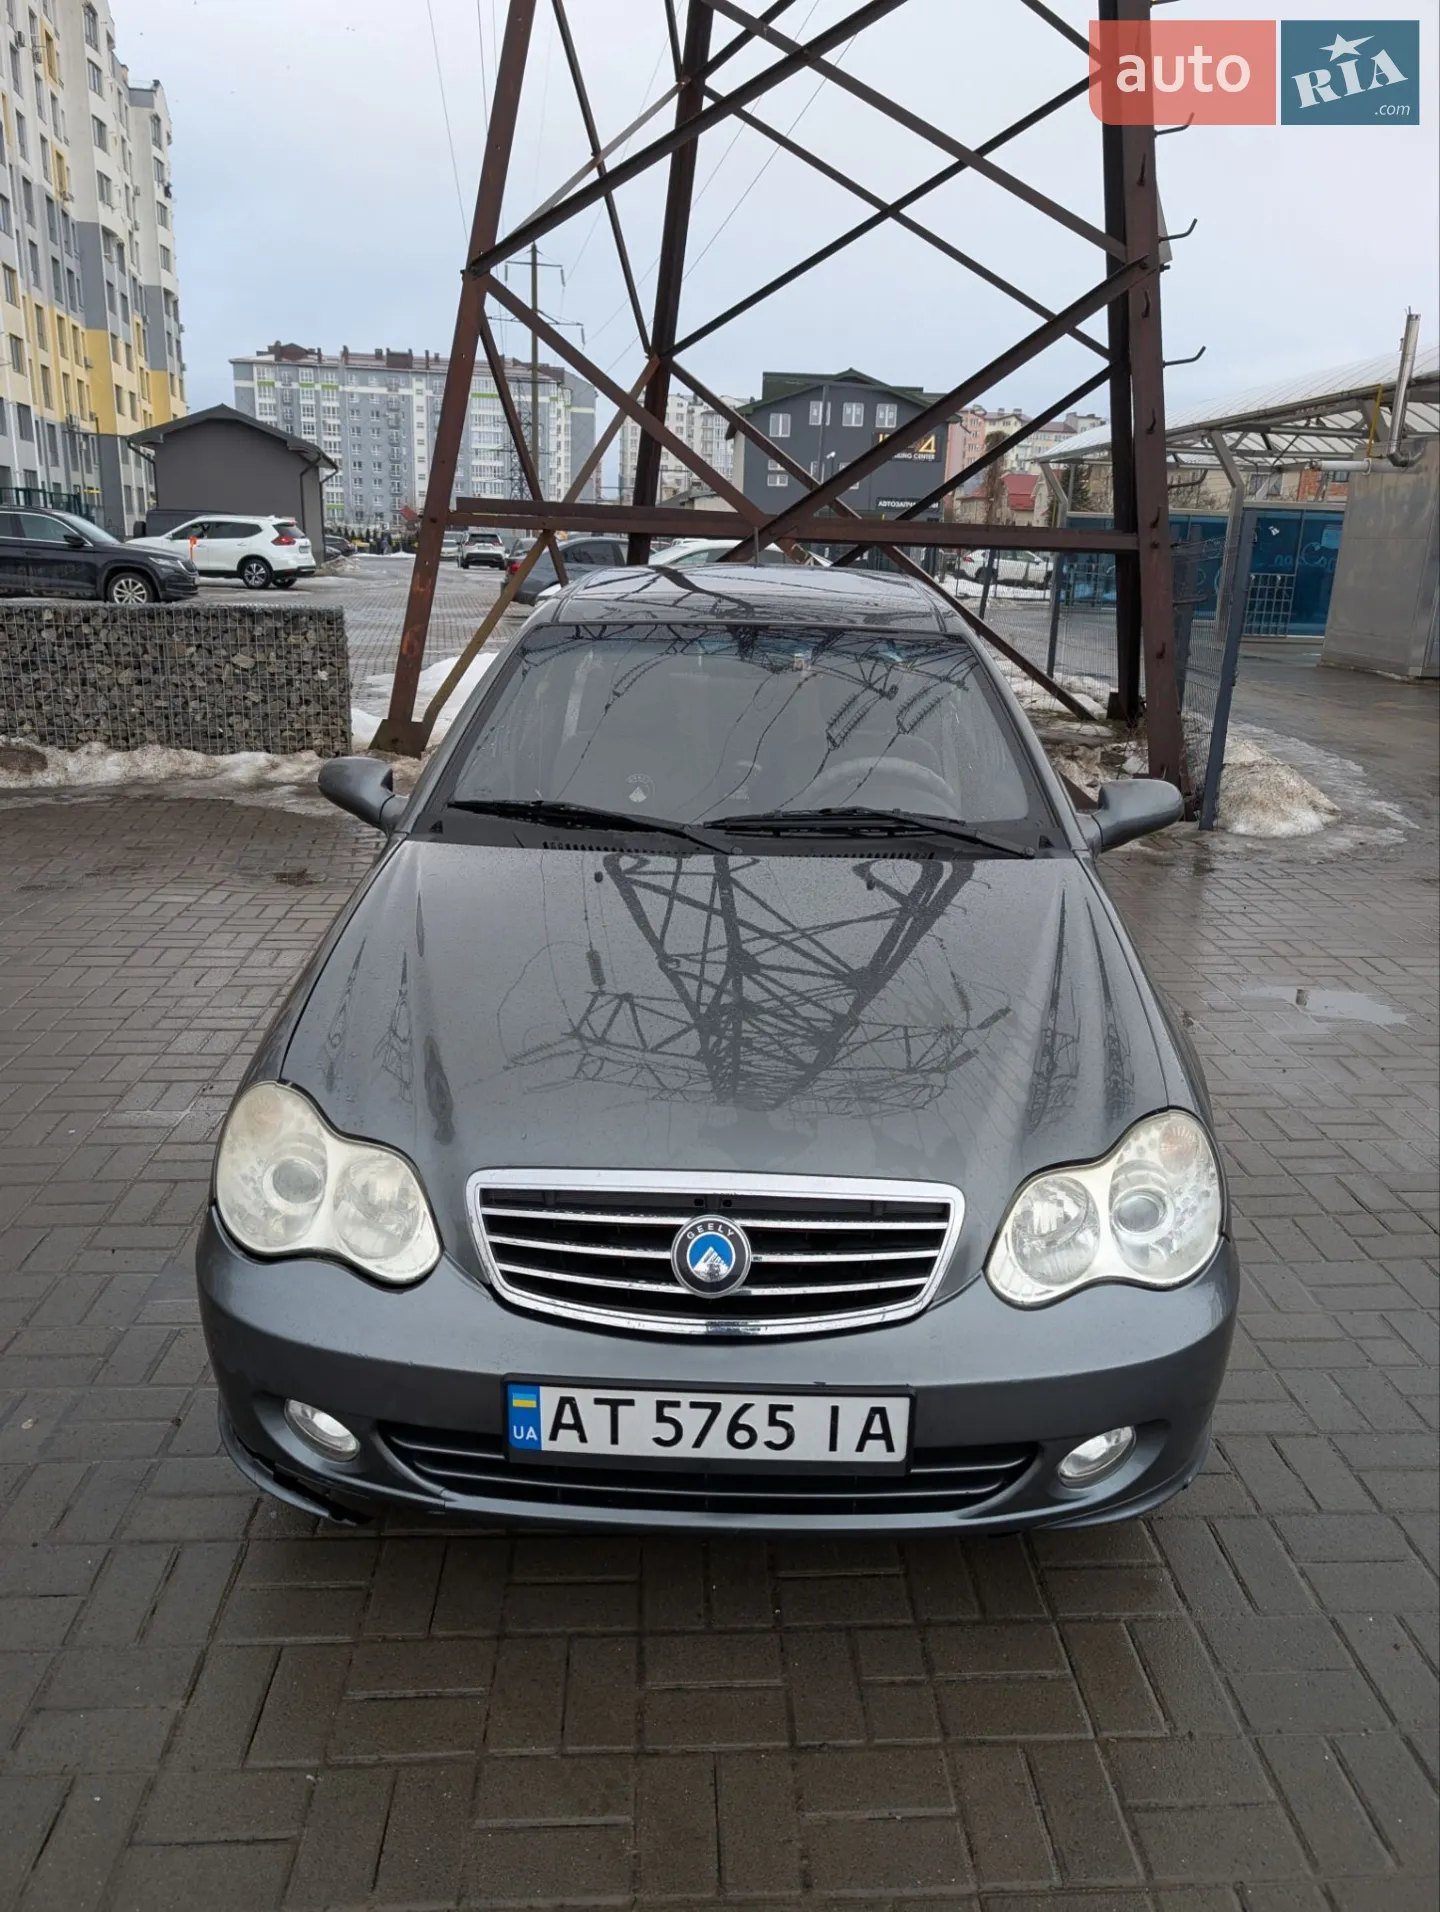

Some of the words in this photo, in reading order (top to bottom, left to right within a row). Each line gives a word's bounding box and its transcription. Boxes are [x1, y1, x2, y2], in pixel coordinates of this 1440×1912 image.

[686, 1222, 735, 1241] GEELY
[512, 1425, 538, 1441] UA
[548, 1395, 635, 1446] AT
[651, 1399, 796, 1451] 5765
[828, 1405, 896, 1453] IA
